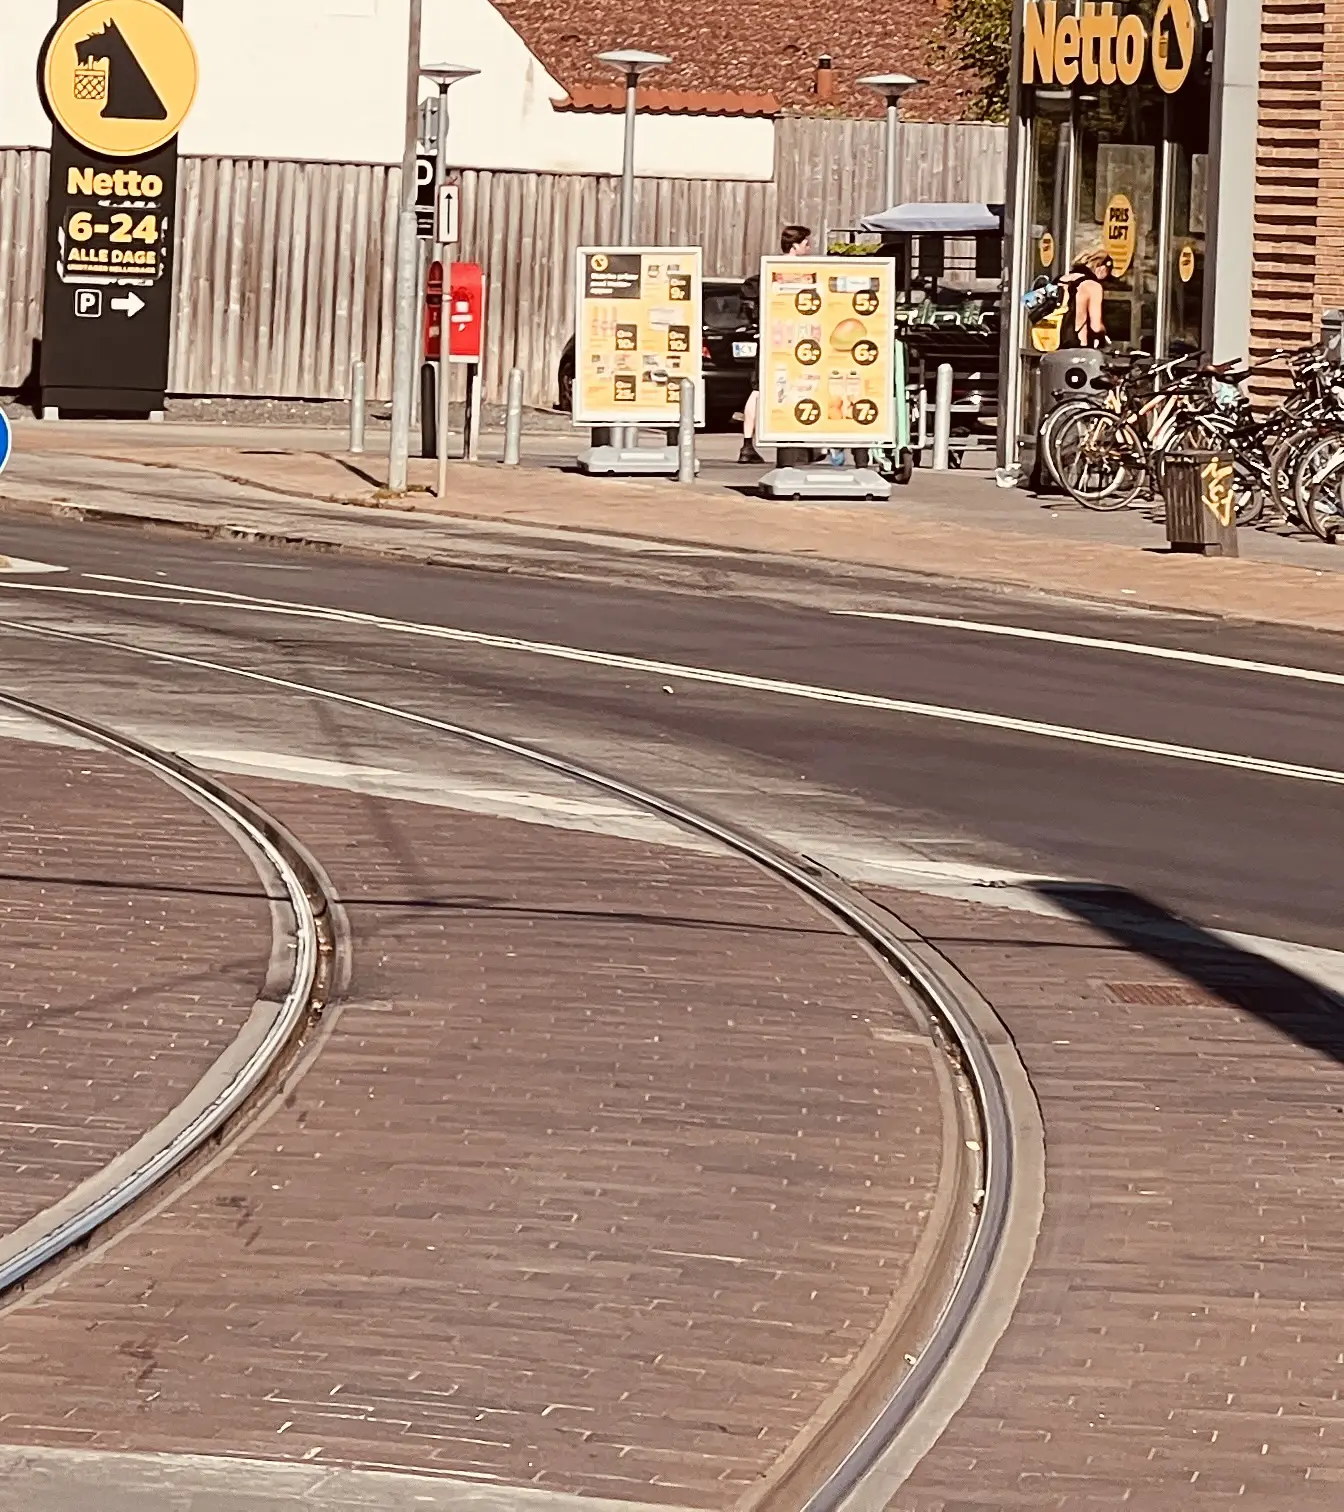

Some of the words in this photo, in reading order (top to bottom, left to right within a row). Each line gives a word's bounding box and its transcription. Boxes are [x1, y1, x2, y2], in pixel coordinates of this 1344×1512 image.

[1022, 0, 1145, 86] Netto
[67, 167, 163, 197] Netto
[68, 211, 159, 244] 6-24
[68, 247, 109, 263] ALLE
[111, 249, 156, 264] DAGE
[80, 293, 96, 312] P
